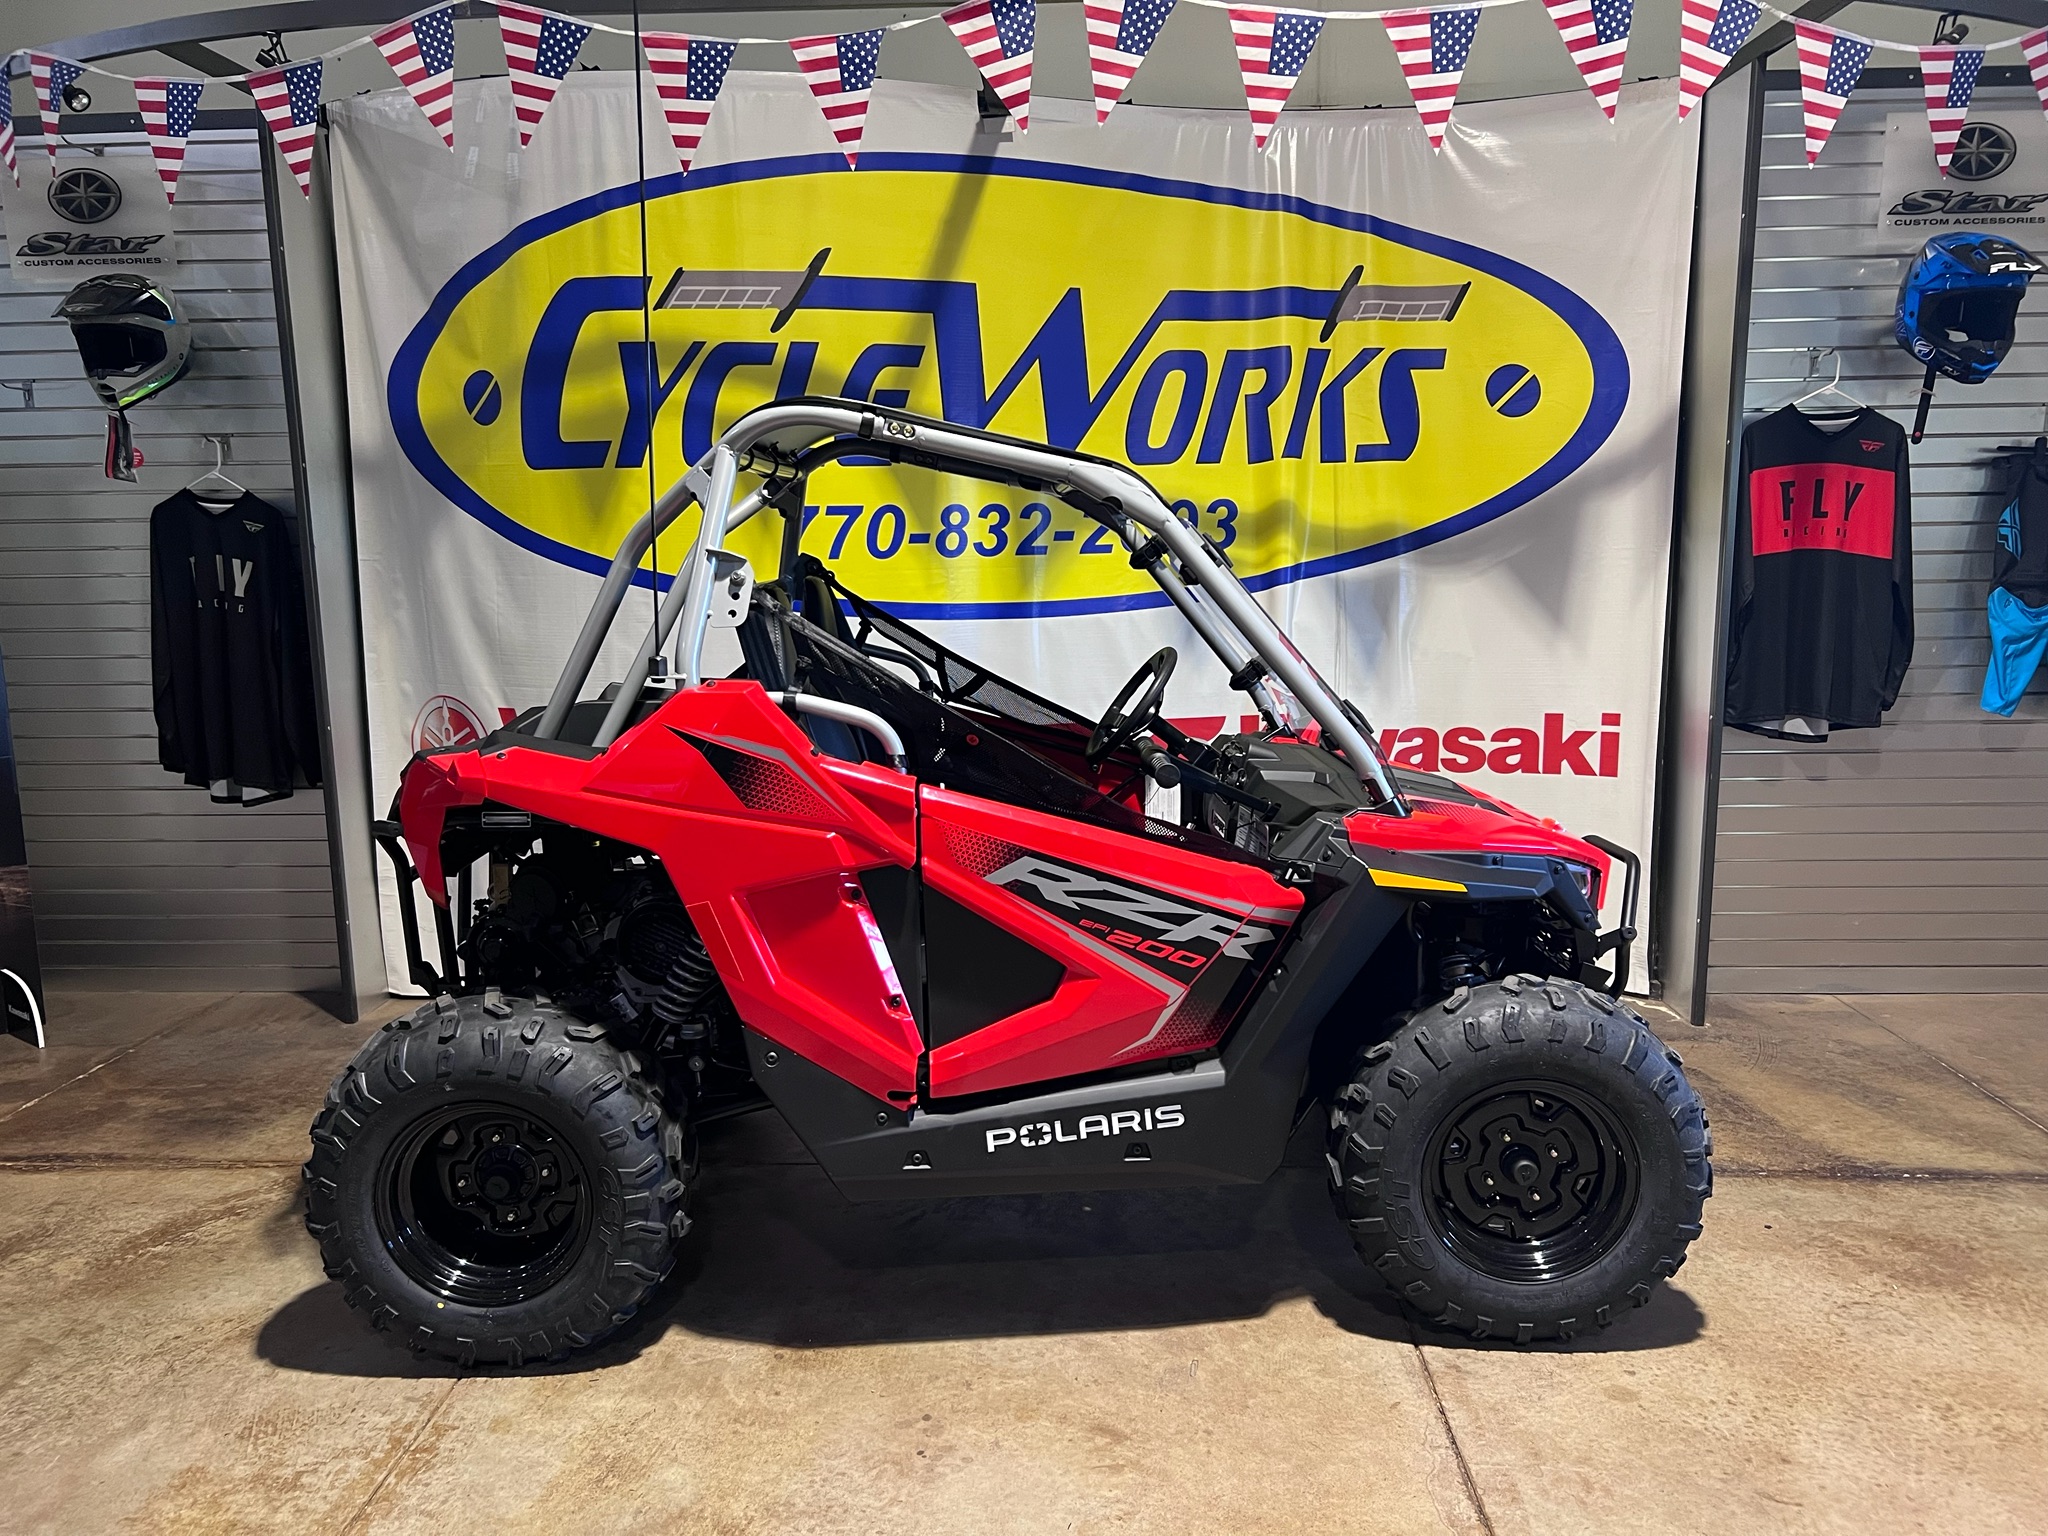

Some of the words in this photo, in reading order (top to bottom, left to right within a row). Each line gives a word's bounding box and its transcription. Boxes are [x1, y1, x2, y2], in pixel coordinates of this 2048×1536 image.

[1886, 189, 2048, 215] Star
[1894, 218, 1950, 227] CUSTOM
[1952, 216, 2046, 226] ACCESSORIES
[15, 231, 166, 257] Star
[24, 258, 75, 268] CUSTOM
[77, 257, 162, 267] ACCESSORIES
[1989, 261, 2043, 274] FLY
[1779, 478, 1866, 521] FLY
[800, 498, 1239, 561] 70-832-23
[982, 855, 1276, 961] RZR
[1105, 929, 1207, 969] 200
[985, 1104, 1186, 1153] POLARIS
